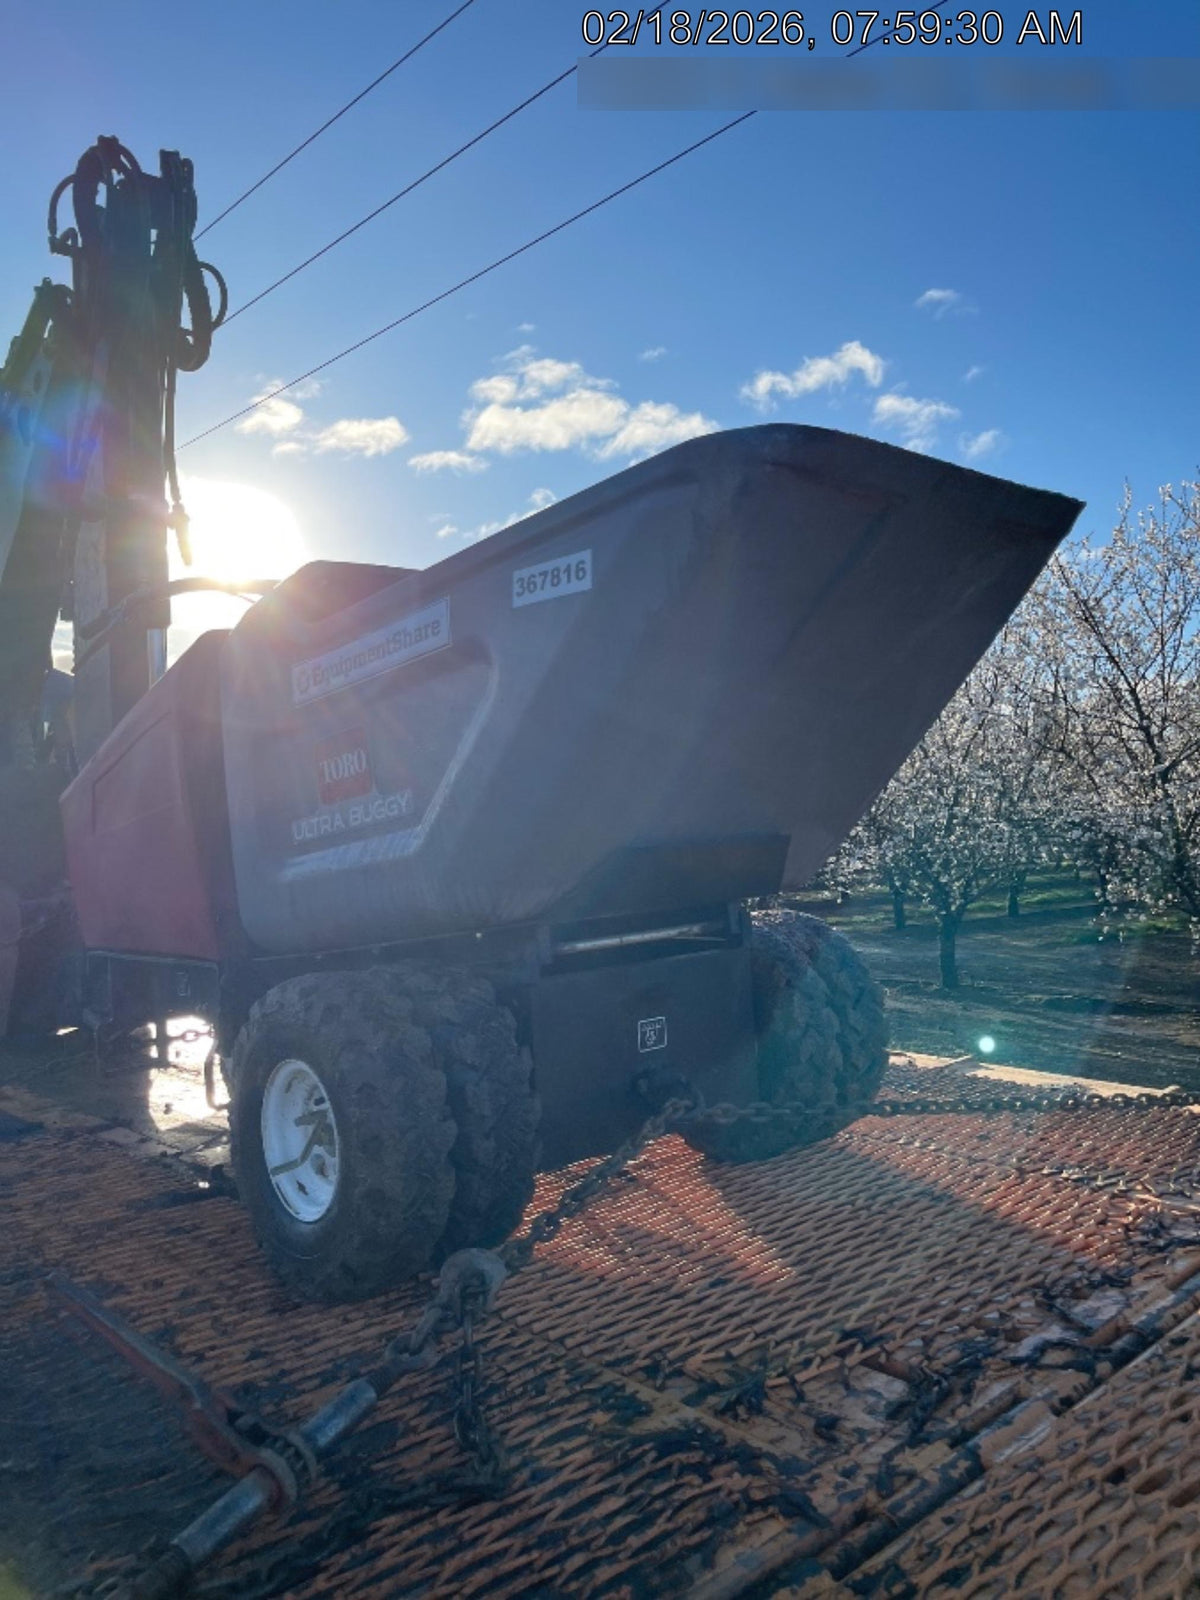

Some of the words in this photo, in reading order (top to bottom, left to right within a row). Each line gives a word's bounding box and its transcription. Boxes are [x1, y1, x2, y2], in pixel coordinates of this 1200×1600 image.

[515, 560, 587, 598] 367816
[311, 618, 441, 687] EquipmentShare
[320, 748, 367, 784] TORO
[292, 812, 345, 840] ULTRA
[349, 788, 412, 826] BUGGY
